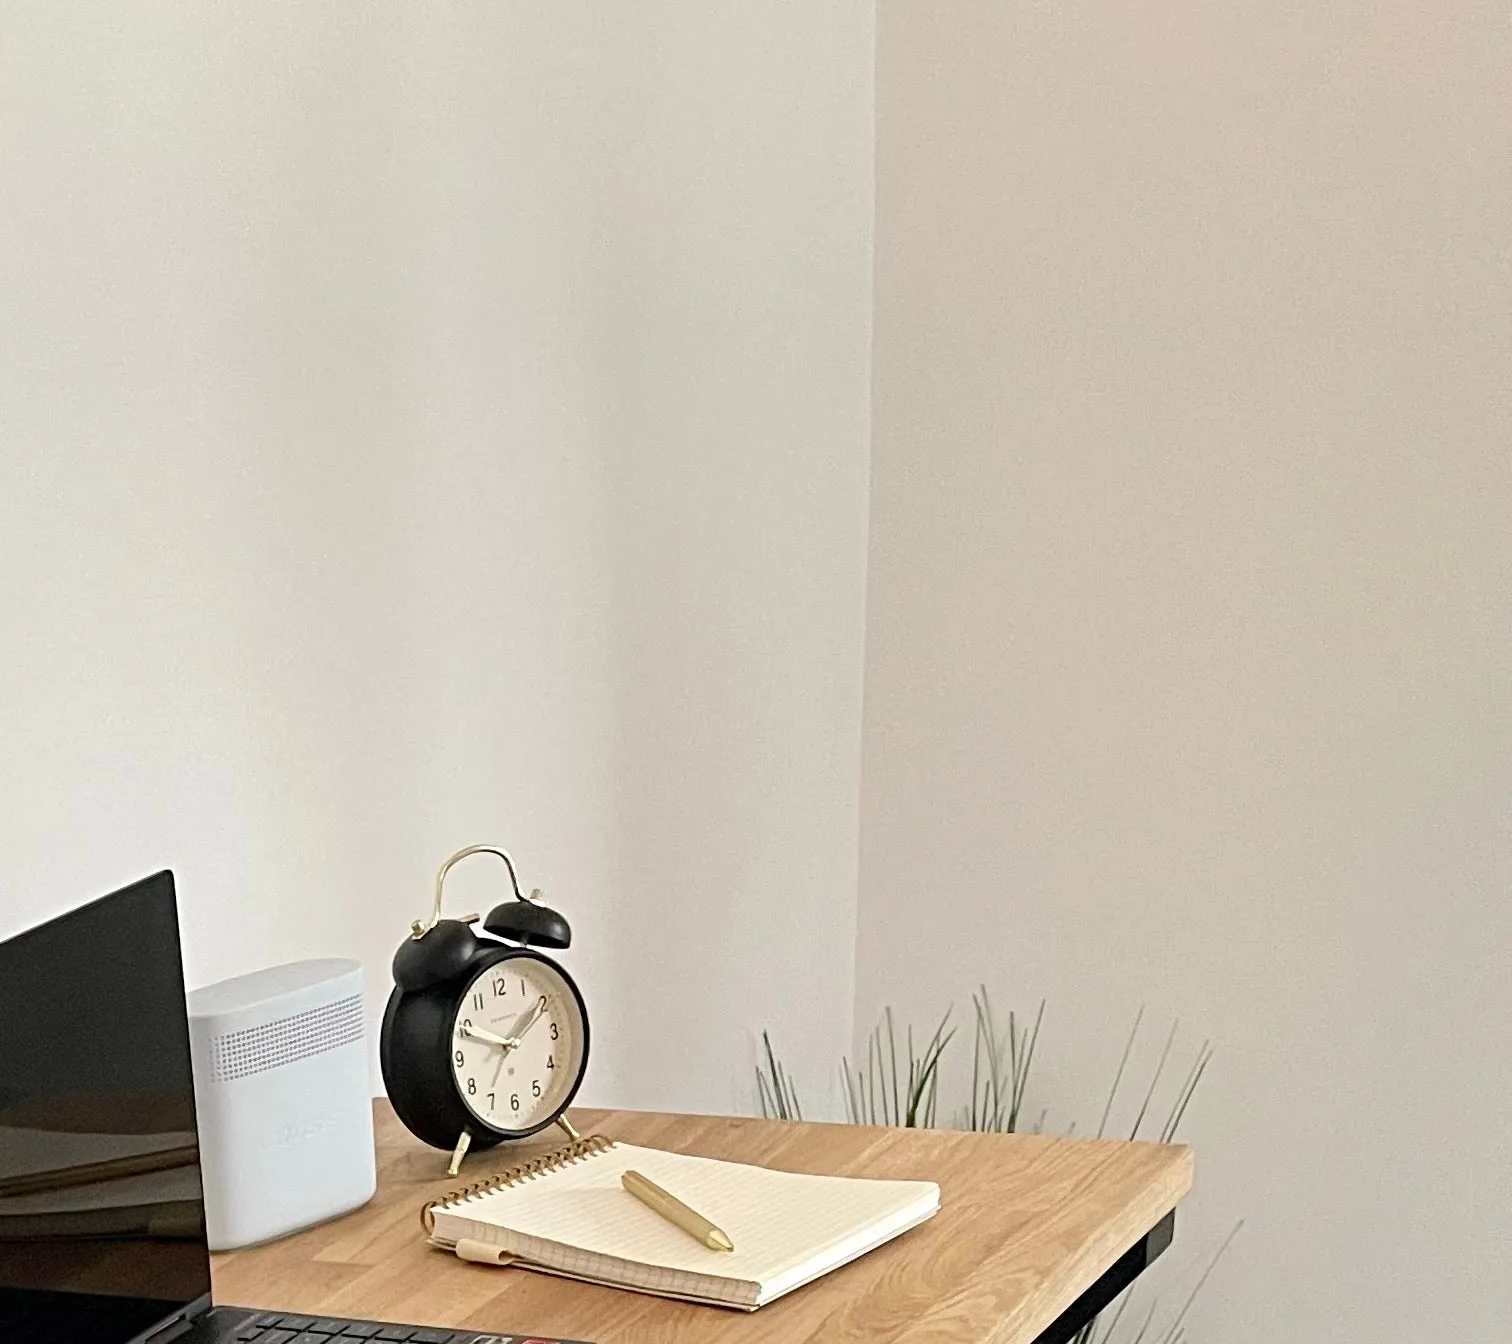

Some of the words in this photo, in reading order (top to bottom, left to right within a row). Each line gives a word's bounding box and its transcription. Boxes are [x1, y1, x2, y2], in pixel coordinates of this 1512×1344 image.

[492, 978, 506, 997] 12
[473, 993, 484, 1011] 11
[549, 1023, 559, 1041] 3
[454, 1050, 464, 1068] 9
[546, 1055, 555, 1070] 4
[467, 1078, 477, 1095] 8
[532, 1080, 541, 1097] 5
[487, 1093, 495, 1110] 7
[510, 1094, 520, 1111] 6
